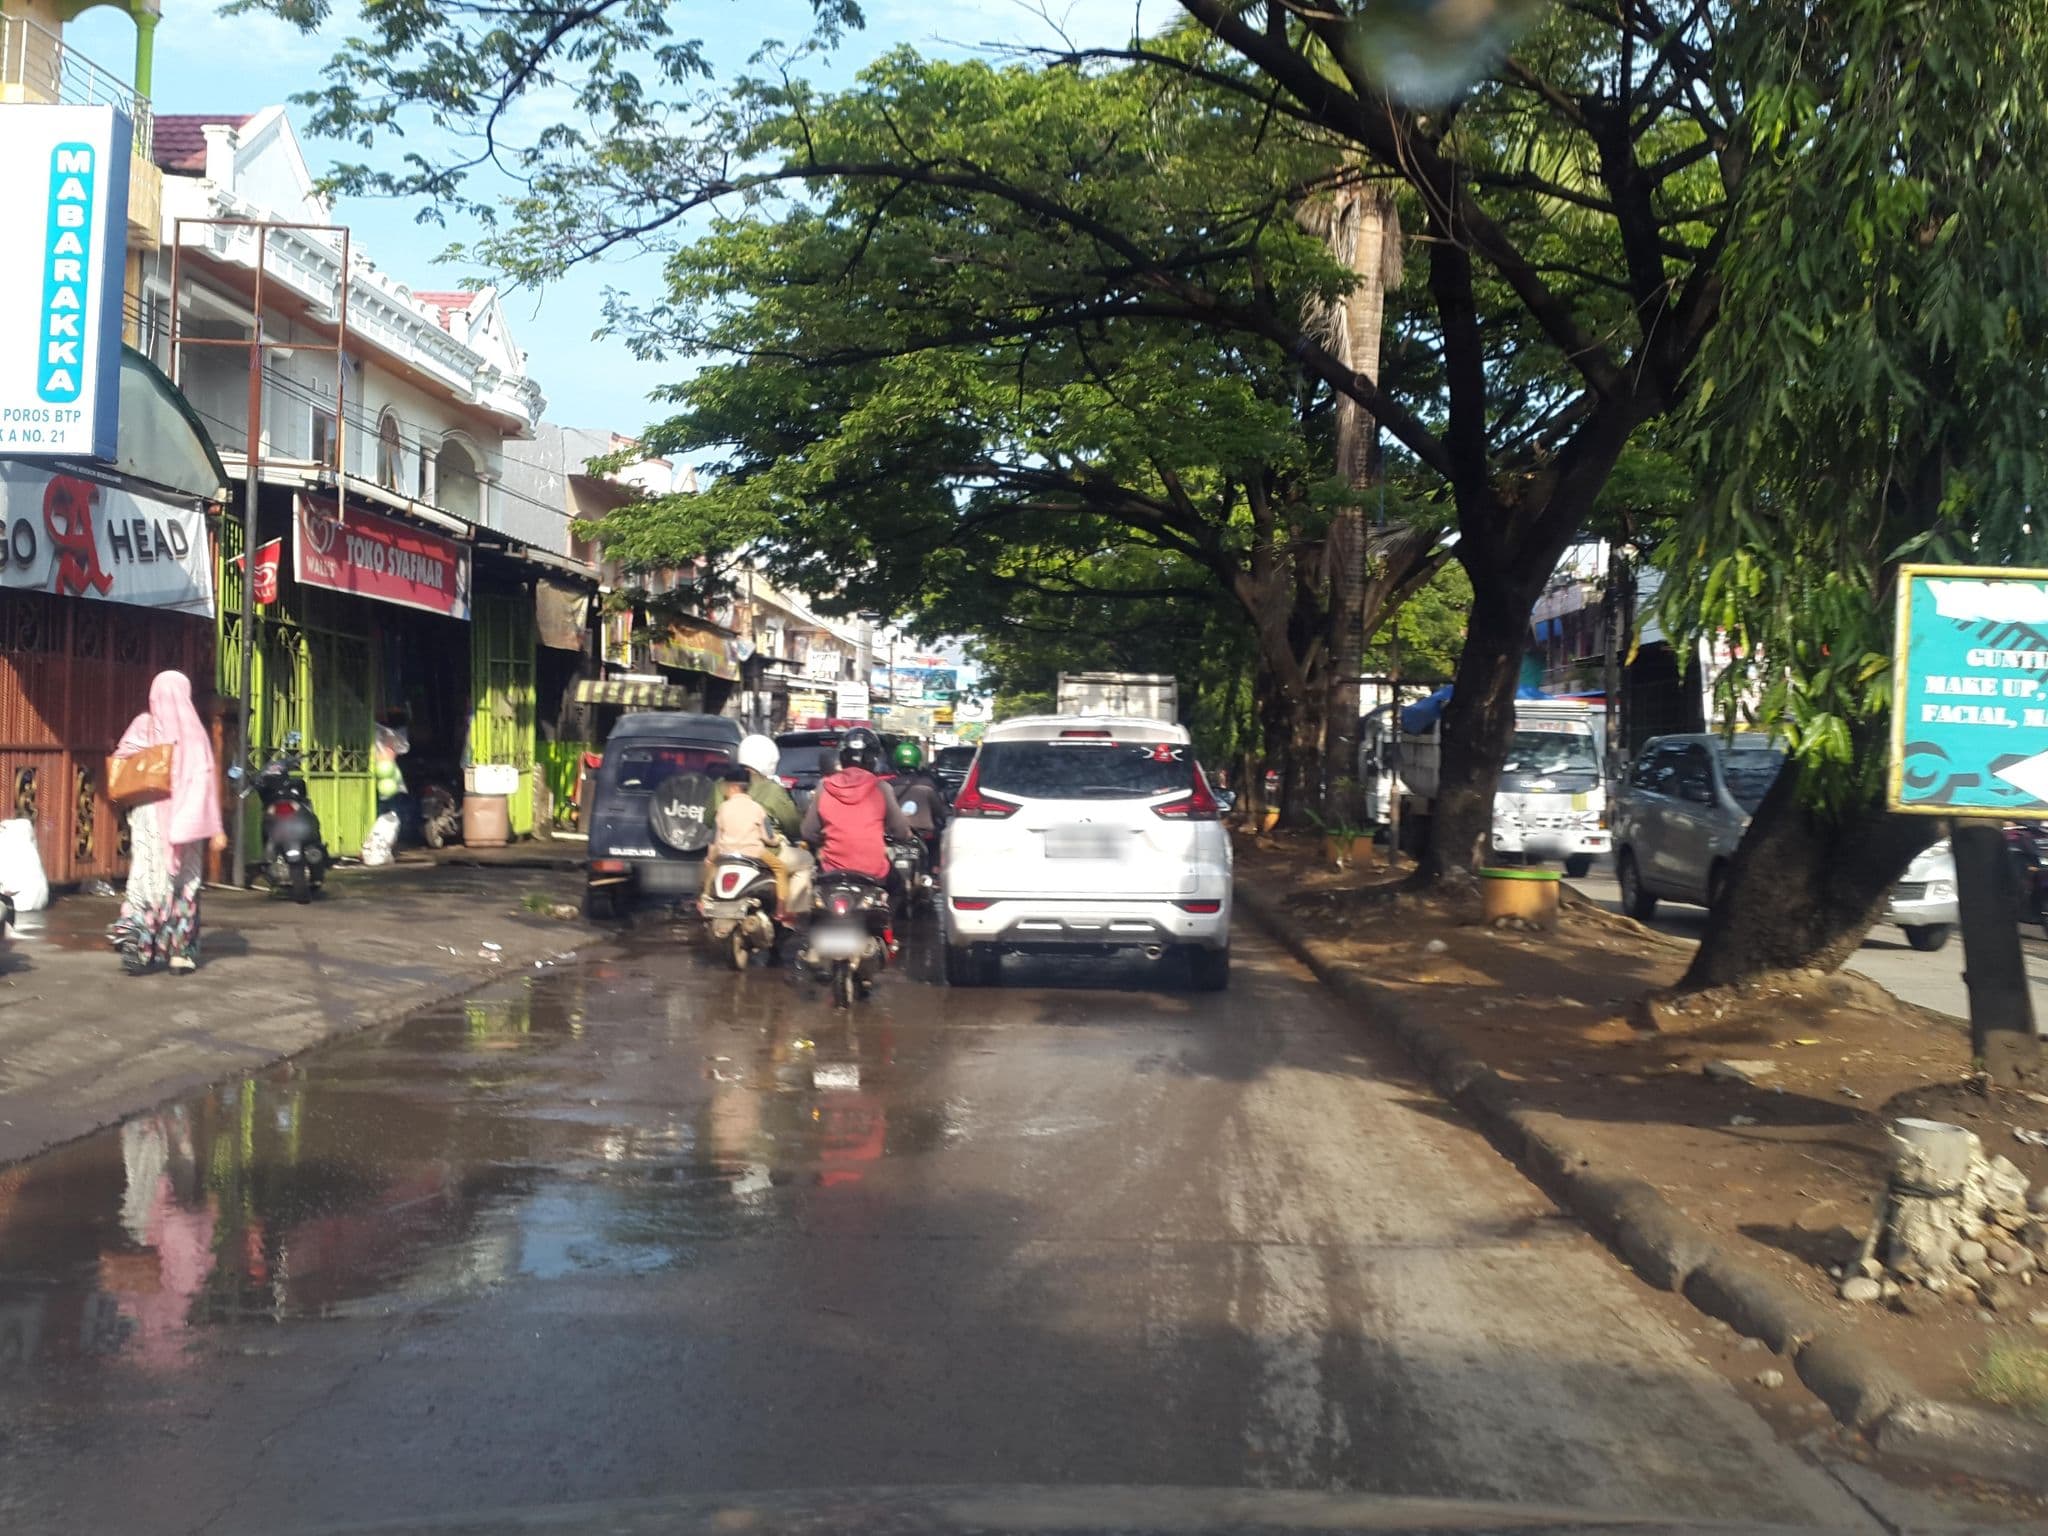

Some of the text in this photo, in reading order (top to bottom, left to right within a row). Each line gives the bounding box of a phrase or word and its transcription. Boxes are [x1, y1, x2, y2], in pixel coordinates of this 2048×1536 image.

[45, 149, 91, 392] MABARAKKA
[3, 408, 81, 423] POROS BTP
[8, 429, 17, 442] A
[22, 429, 45, 443] NO.
[50, 429, 65, 444] 21
[107, 518, 189, 564] HEAD
[346, 535, 385, 574] TOKO
[1924, 675, 1999, 697] MAKE
[1921, 704, 2048, 728] FACIAL, M
